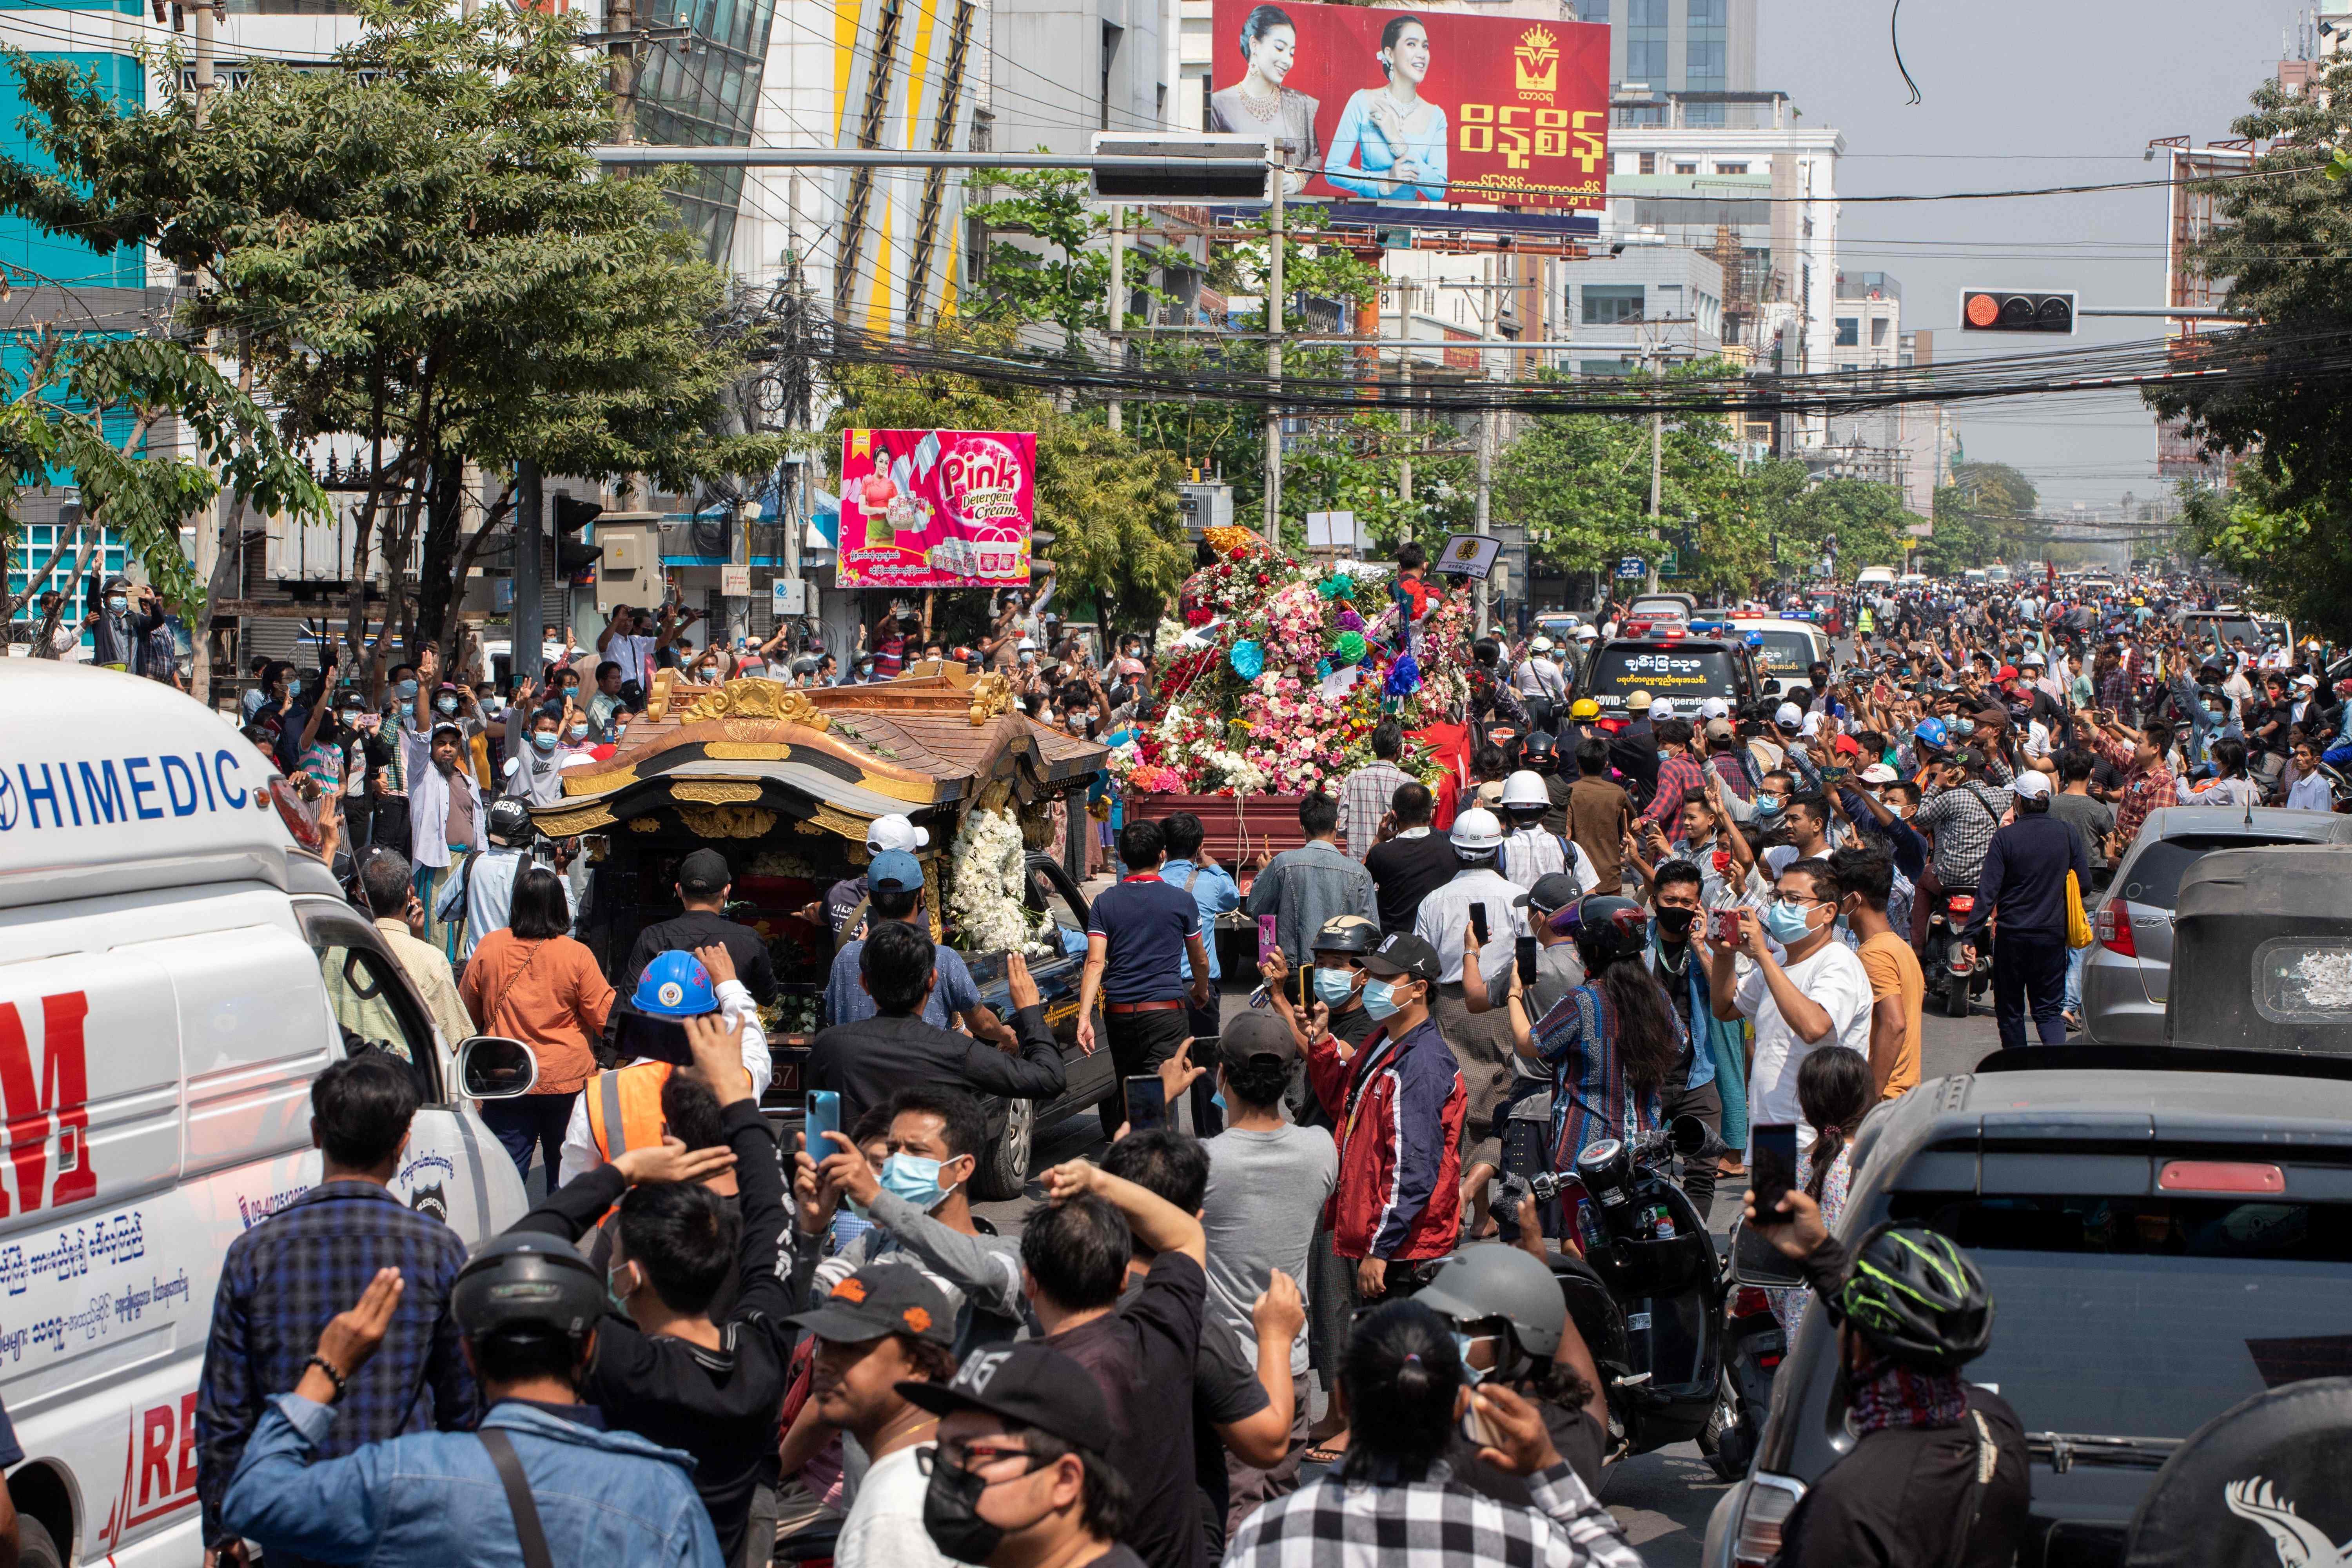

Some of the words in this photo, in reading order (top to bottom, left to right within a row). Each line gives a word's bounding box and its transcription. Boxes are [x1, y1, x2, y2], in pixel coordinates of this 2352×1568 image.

[1533, 37, 1544, 45] ES
[1518, 91, 1555, 107] ထာဝရ
[942, 453, 1020, 500] Pink
[963, 492, 1013, 508] Detergent
[975, 506, 1017, 519] Cream
[1459, 541, 1476, 559] 奠
[1625, 655, 1701, 672] ချမ်းမြသုခ
[1333, 675, 1343, 689] 奠
[1616, 674, 1707, 686] ပရဟိတလူမှုကူညီရေးအသင်း
[1594, 695, 1620, 706] COVID
[1668, 697, 1706, 707] Operatio
[18, 750, 247, 828] HIMEDIC
[492, 800, 523, 816] PRESS
[416, 1197, 446, 1218] RESCUE
